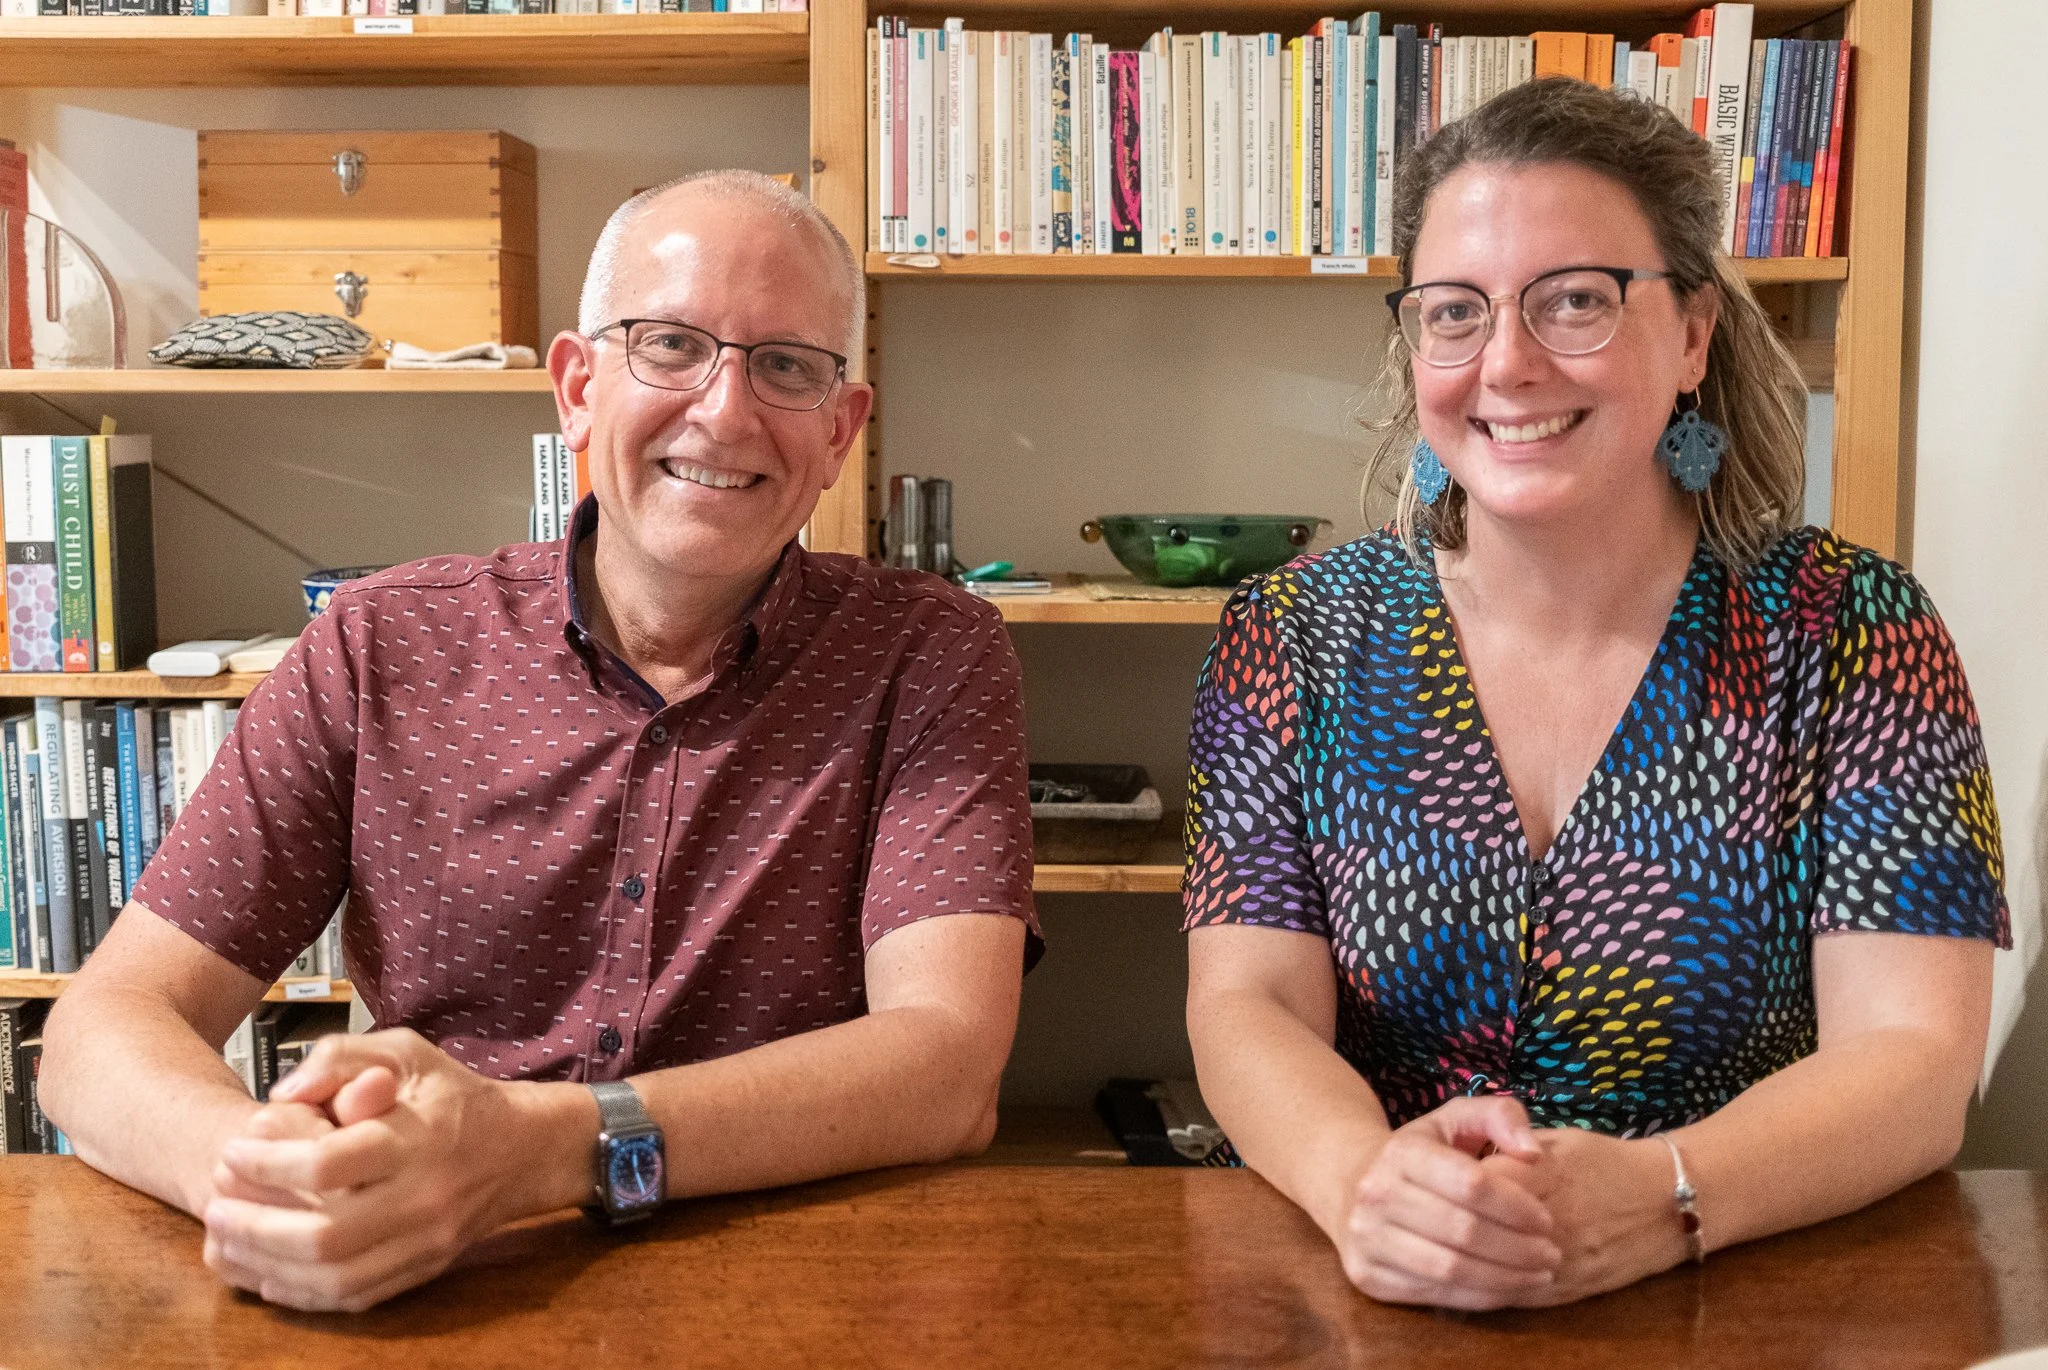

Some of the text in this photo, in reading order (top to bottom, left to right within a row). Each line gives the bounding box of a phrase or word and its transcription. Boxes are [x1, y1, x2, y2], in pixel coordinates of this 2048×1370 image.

[950, 43, 959, 82] BATAILLE
[1095, 55, 1106, 85] Bataille
[1314, 40, 1322, 80] BAUDRILLARD
[950, 84, 959, 128] GEORGES
[1716, 84, 1740, 129] BASIC
[1809, 110, 1817, 139] Introduction
[1314, 169, 1322, 202] MAJORITIES
[539, 445, 549, 506] HAN KANG
[560, 445, 569, 469] HAN
[561, 472, 570, 506] KANG
[61, 446, 83, 590] DUST CHILD
[101, 721, 112, 738] Jay
[8, 741, 19, 798] HOMO SACER
[87, 748, 98, 811] EDGEWORK
[45, 723, 67, 896] REGULATING AVERSION
[124, 765, 135, 838] ENCHANTMENT
[102, 767, 123, 909] REFRACTIONS OF VIOLENCE
[76, 824, 90, 900] WENDY BROWN
[1, 1020, 13, 1079] DICTIONARY
